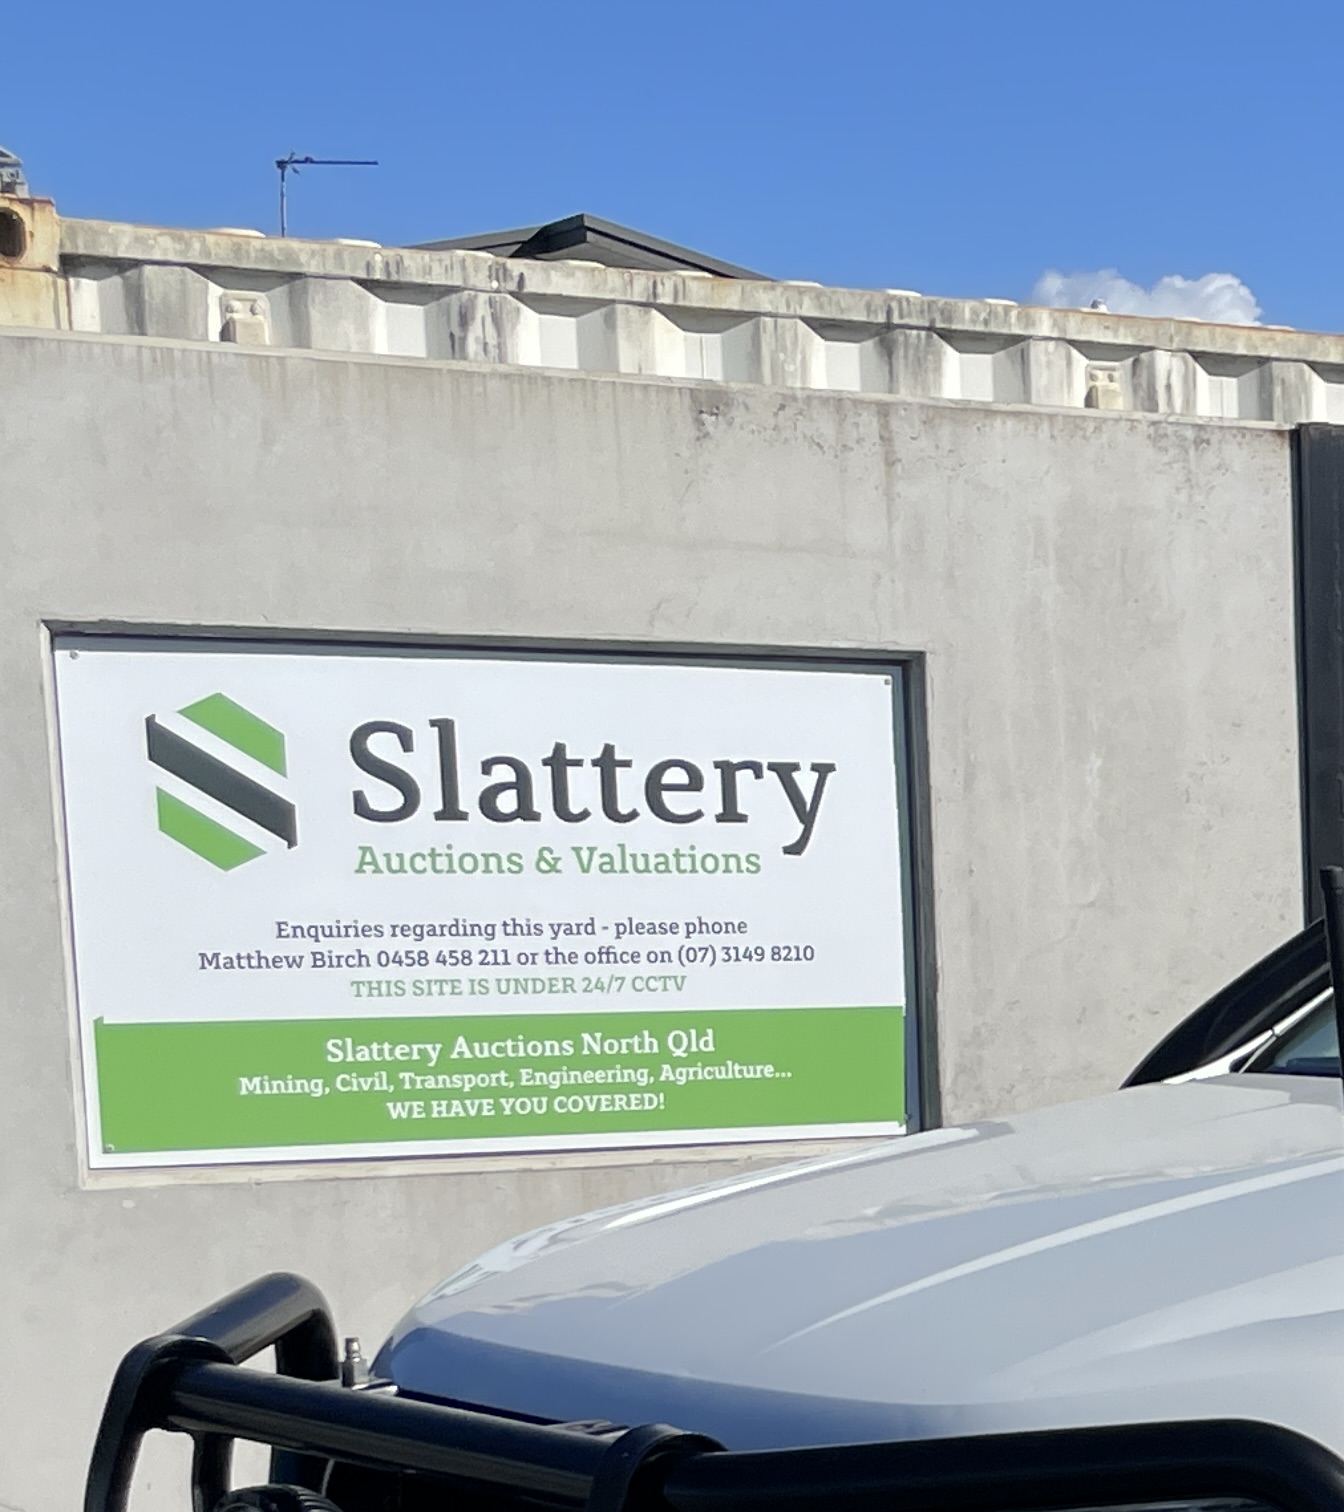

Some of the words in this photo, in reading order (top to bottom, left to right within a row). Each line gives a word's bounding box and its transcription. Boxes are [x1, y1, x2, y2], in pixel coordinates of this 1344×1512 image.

[349, 717, 837, 858] Slattery
[353, 843, 524, 875] Auctions
[534, 846, 563, 875] &
[570, 842, 762, 875] Valuations
[275, 919, 385, 944] Enquiries
[389, 917, 497, 942] regarding
[501, 917, 543, 938] this
[548, 916, 597, 942] yard
[614, 916, 680, 940] please
[684, 915, 748, 940] phone
[198, 949, 305, 970] Matthew
[310, 948, 372, 969] Birch
[376, 949, 430, 968] 0458
[434, 949, 474, 967] 458
[477, 948, 512, 966] 211
[516, 952, 540, 966] or
[543, 946, 579, 966] the
[583, 944, 641, 965] office
[646, 950, 674, 964] on
[677, 944, 717, 968] (07)
[720, 945, 766, 963] 3149
[770, 944, 815, 962] 8210
[351, 979, 406, 998] THIS
[412, 978, 464, 997] SITE
[468, 978, 490, 996] IS
[494, 976, 578, 996] UNDER
[581, 973, 627, 994] 24/7
[631, 975, 688, 993] CCTV
[326, 1037, 443, 1067] Slattery
[449, 1034, 575, 1059] Auctions
[580, 1029, 660, 1055] North
[666, 1028, 715, 1058] Qld
[238, 1074, 331, 1098] Mining,
[335, 1070, 395, 1093] Civil,
[398, 1069, 515, 1093] Transport,
[519, 1064, 655, 1090] Engineering,
[658, 1060, 792, 1086] Agriculture...
[387, 1100, 428, 1120] WE
[434, 1098, 496, 1119] HAVE
[498, 1096, 549, 1116] YOU
[552, 1092, 665, 1114] COVERED!
